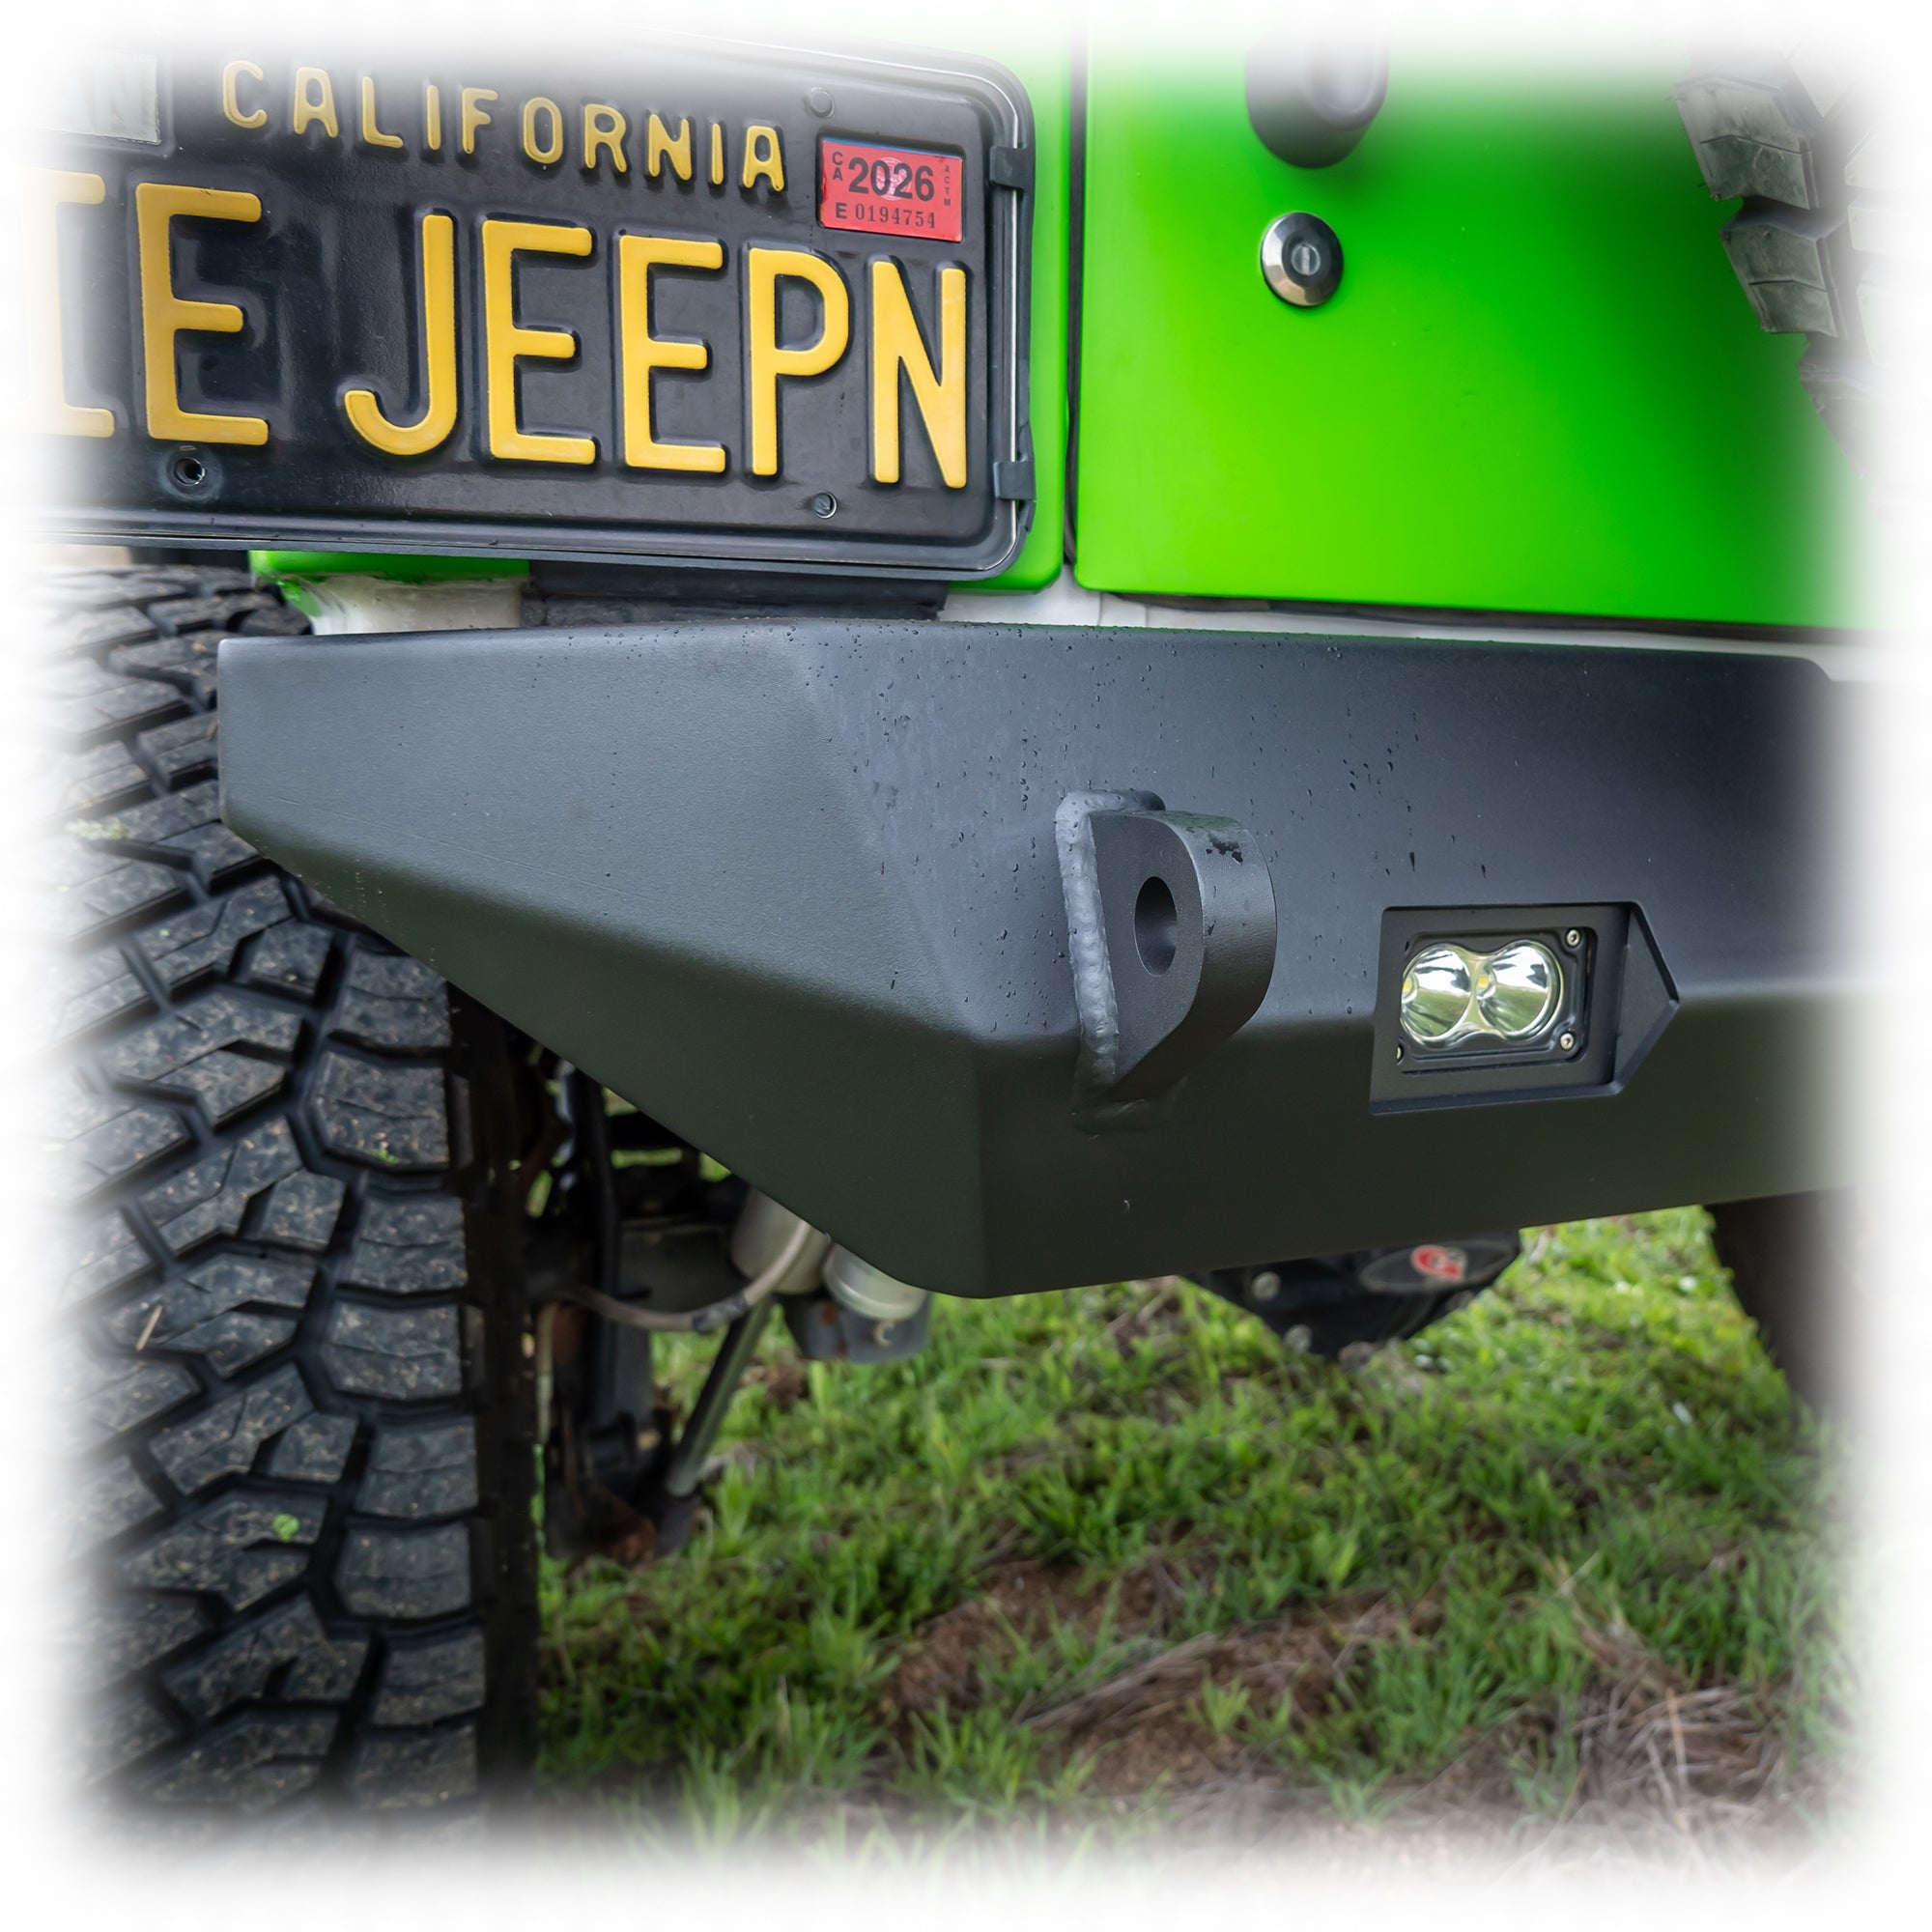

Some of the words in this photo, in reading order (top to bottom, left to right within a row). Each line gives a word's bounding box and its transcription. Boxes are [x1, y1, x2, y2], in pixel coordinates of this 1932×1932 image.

[221, 60, 784, 191] CALIFORNIA
[832, 152, 843, 182] CA
[848, 156, 935, 202] 2026
[836, 202, 848, 219] E
[855, 203, 936, 229] 0194754
[344, 214, 966, 489] JEEPN
